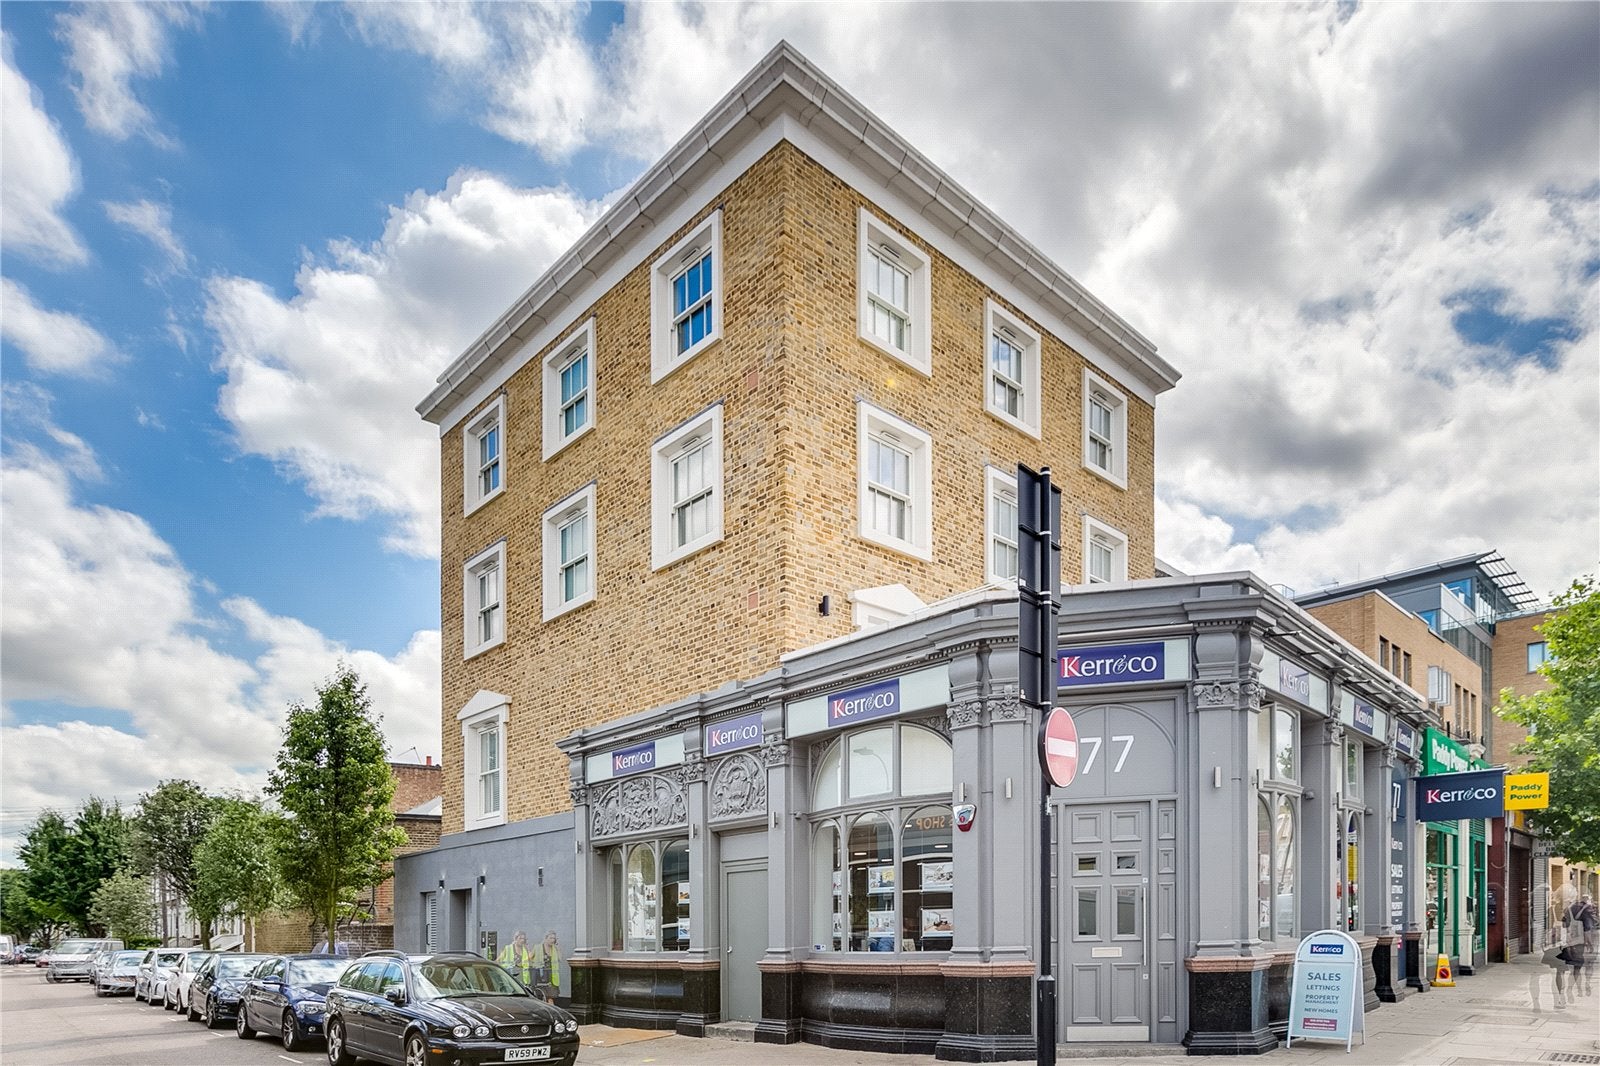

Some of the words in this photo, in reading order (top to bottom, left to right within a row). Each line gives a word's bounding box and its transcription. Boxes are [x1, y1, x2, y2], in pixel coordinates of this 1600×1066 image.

[1080, 735, 1134, 775] 77
[1307, 972, 1341, 981] SALES
[509, 1049, 530, 1058] RV59
[531, 1048, 548, 1057] PWZ
